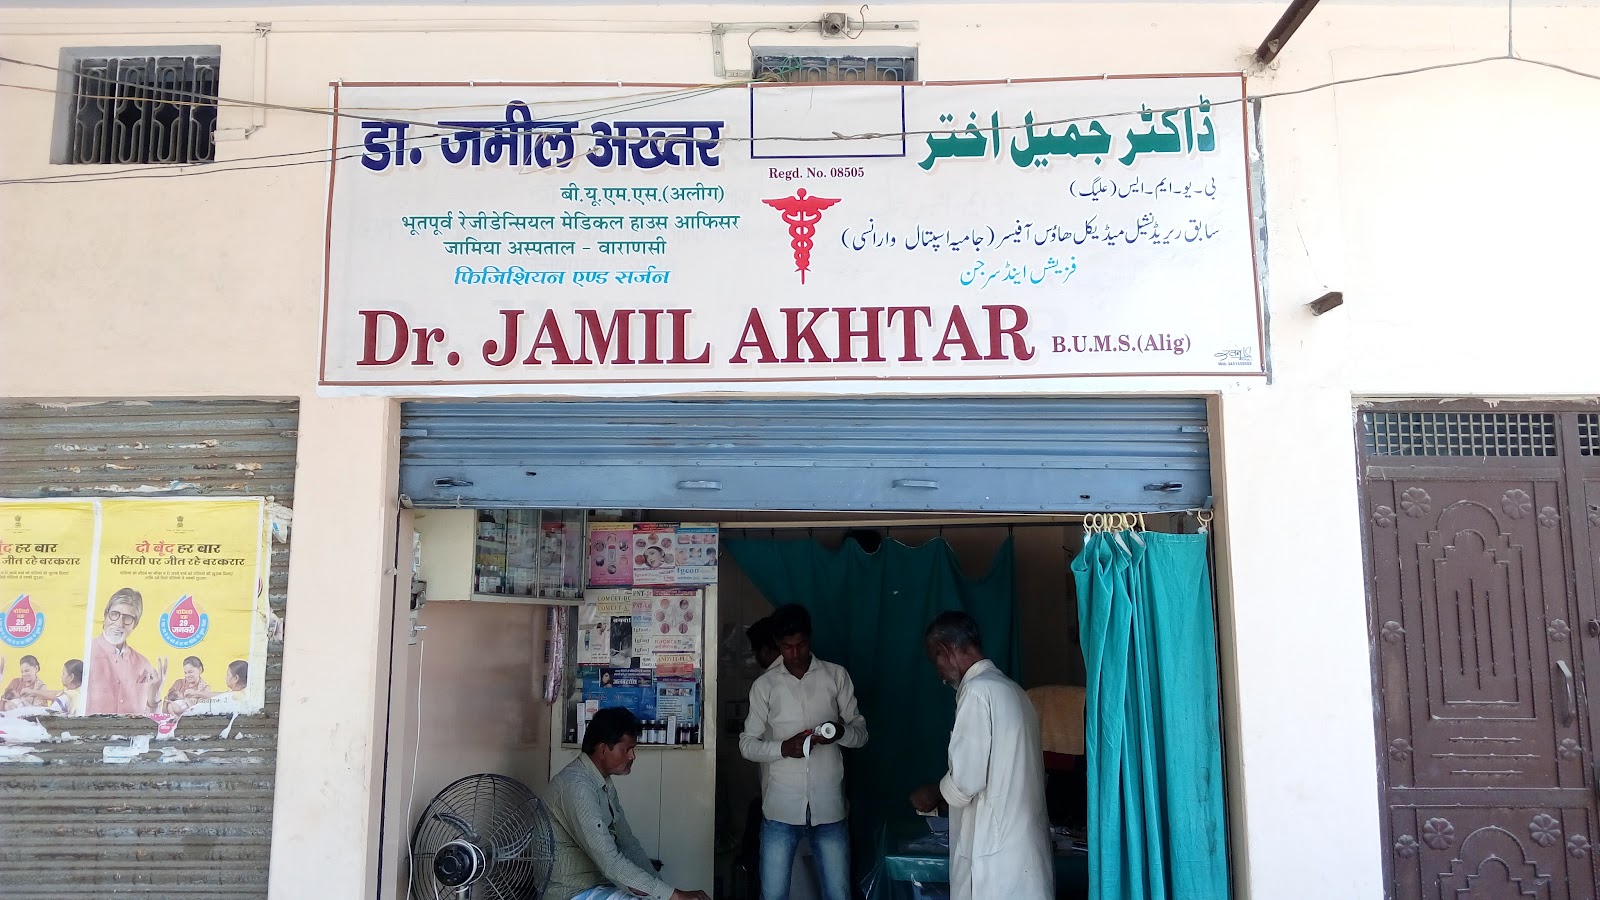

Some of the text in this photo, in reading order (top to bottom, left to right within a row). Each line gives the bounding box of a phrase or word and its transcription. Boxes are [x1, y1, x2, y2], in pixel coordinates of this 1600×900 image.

[360, 99, 725, 172] डा. जमील अख्तर
[917, 93, 1216, 171] ڈاکٹر جمیل اختر
[768, 167, 865, 181] Regd. No. 08505
[401, 210, 741, 236] भूतपूर्व रेजीडेन्सियल मेडिकल हाउस आफिसर
[443, 236, 502, 256] जामिया
[507, 241, 576, 256] अस्पताल
[597, 236, 668, 256] वाराणसी
[454, 265, 672, 288] फिजिशियन एण्ड सर्जन
[356, 304, 1192, 368] Dr. JAMIL AKHTAR B.U.M.S.(Alig)
[15, 543, 32, 554] हर
[34, 543, 59, 554] बार
[135, 540, 222, 557] दो बूँद हर बार
[109, 554, 147, 566] पोलियो
[148, 557, 162, 566] पर
[163, 554, 187, 566] जीत
[8, 623, 32, 633] जनवरी
[171, 624, 196, 634] जनवरी
[178, 619, 189, 627] 29
